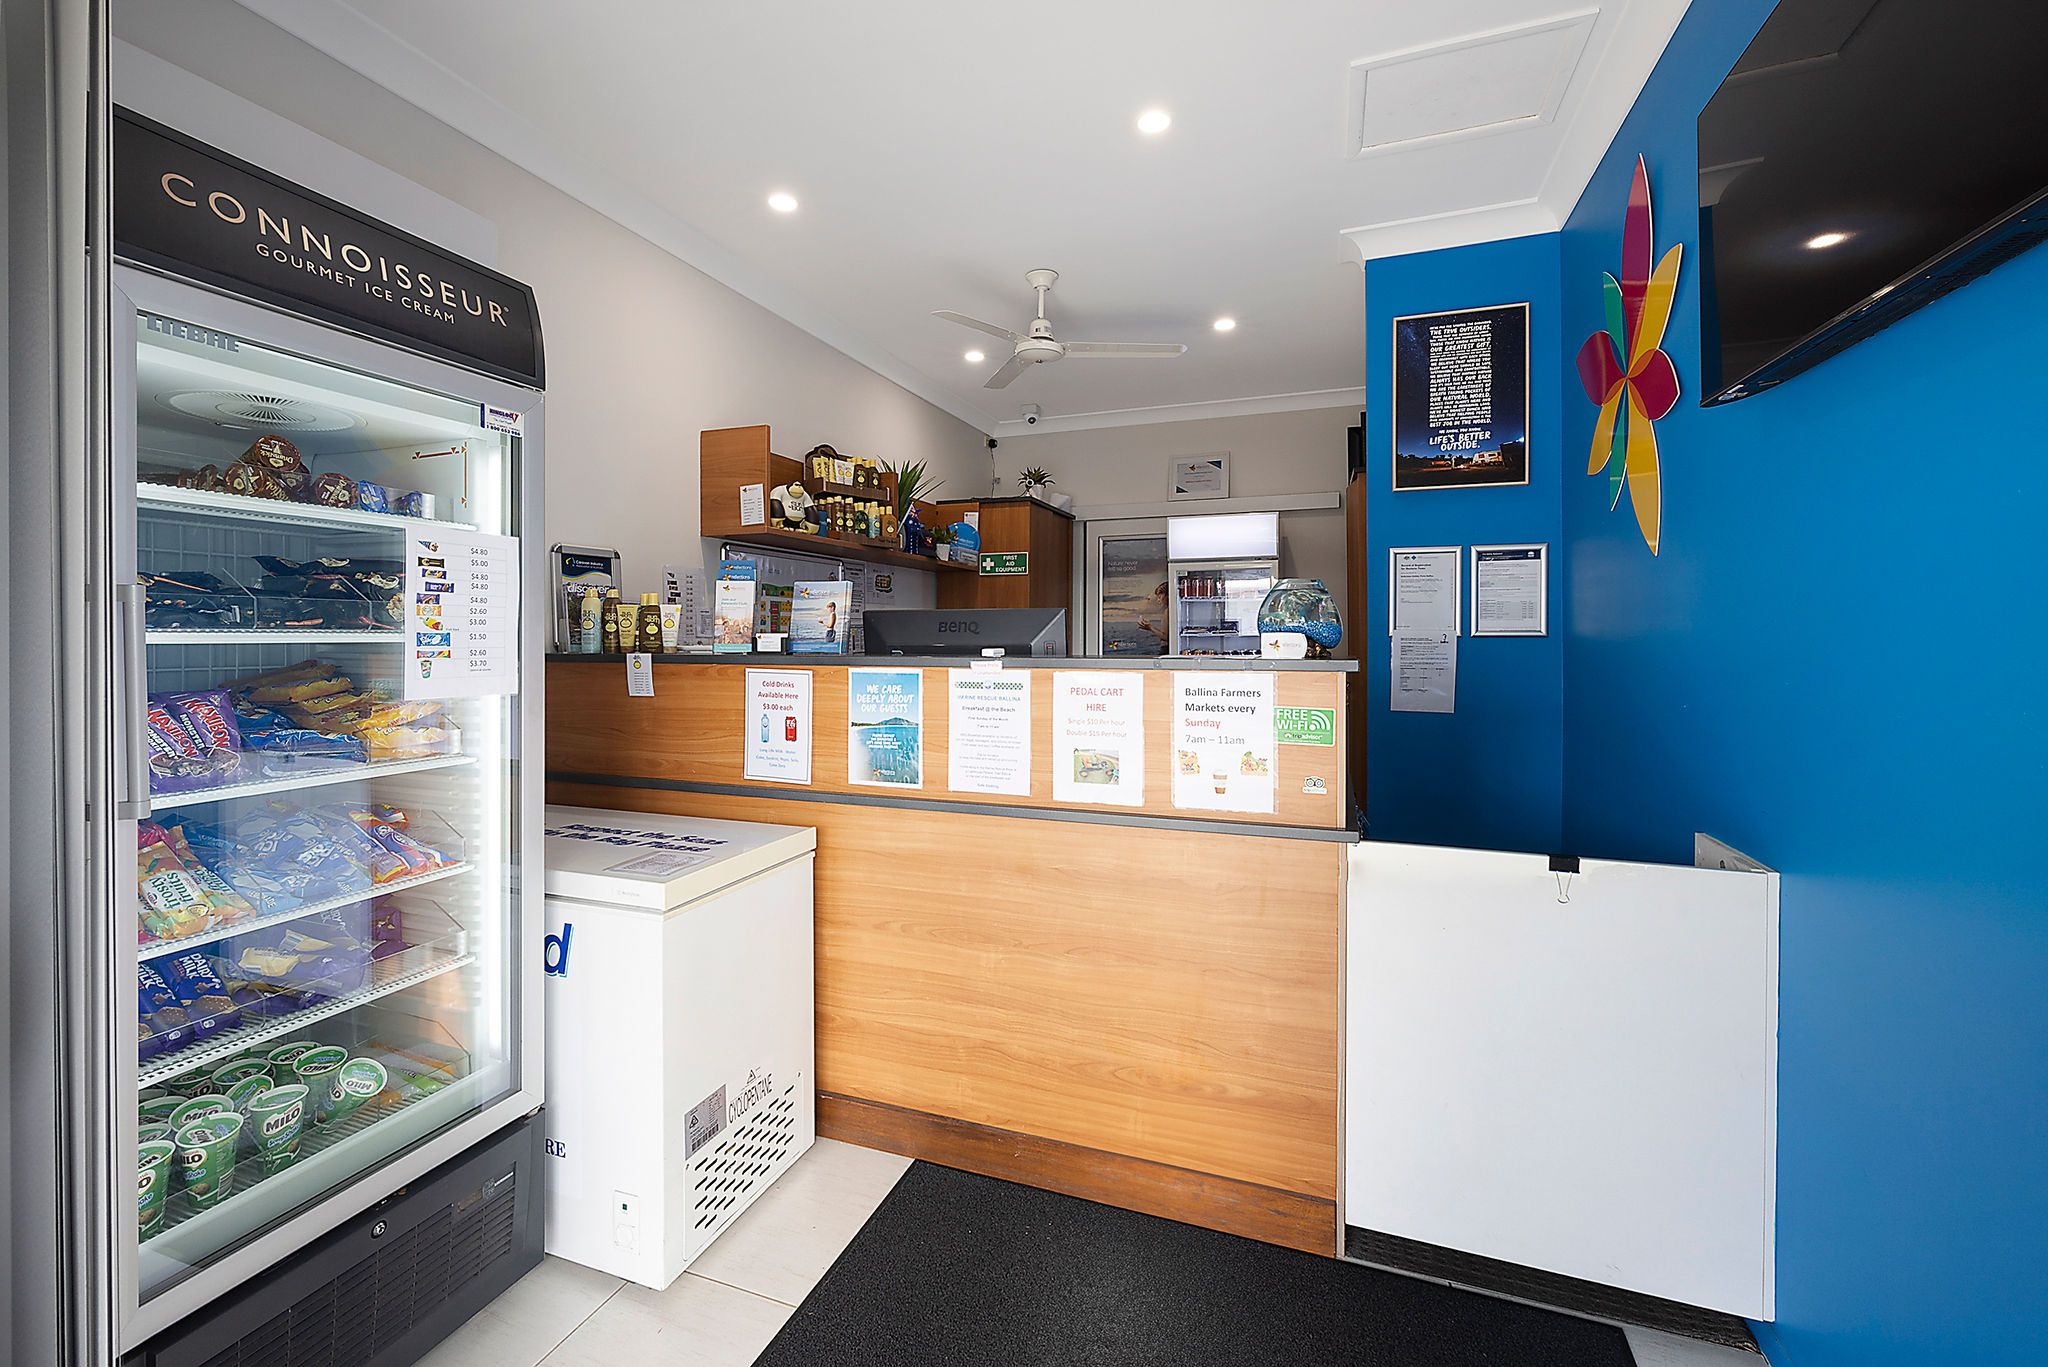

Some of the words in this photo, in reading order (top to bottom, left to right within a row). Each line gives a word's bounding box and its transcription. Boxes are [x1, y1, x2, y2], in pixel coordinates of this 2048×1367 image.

[161, 172, 507, 328] CONNOISSEUR
[256, 243, 356, 288] GOURMET
[365, 282, 393, 303] ICE
[401, 296, 455, 325] CREAM
[1445, 343, 1474, 351] GREATEST
[1430, 435, 1454, 445] LIFE'S
[1459, 431, 1490, 441] BETTER
[1441, 440, 1480, 451] OUTSIDE.
[471, 547, 488, 556] $4.80
[471, 559, 488, 567] $5.00
[471, 573, 488, 581] $4.80
[471, 582, 488, 590] $4.80
[470, 596, 488, 604] $4.80
[470, 607, 487, 615] $2.60
[469, 618, 487, 626] $3.00
[938, 621, 980, 634] BenQ
[469, 633, 486, 641] $1.50
[469, 649, 487, 657] $2.60
[470, 659, 487, 667] $3.70
[866, 684, 880, 694] WE
[881, 684, 903, 695] CARE
[1070, 687, 1098, 696] PEDAL
[1100, 687, 1124, 696] CART
[1185, 687, 1218, 697] Ballina
[1221, 688, 1261, 698] Farmers
[856, 694, 886, 704] DEEPLY
[887, 694, 915, 704] ABOUT
[762, 702, 779, 710] $3.00
[861, 704, 877, 713] OUR
[879, 704, 908, 713] GUESTS
[1086, 703, 1107, 711] HIRE
[1185, 702, 1225, 713] Markets
[1228, 705, 1256, 715] every
[1276, 708, 1308, 720] FREE
[177, 698, 231, 749] MAXIBON
[1184, 718, 1221, 729] Sunday
[1276, 720, 1308, 731] WI-FI
[179, 712, 206, 751] MONSTER
[148, 724, 179, 760] ONSTER
[1185, 734, 1206, 743] 7am
[1218, 735, 1245, 745] 11am
[166, 871, 195, 903] fruits
[149, 877, 181, 910] frosty
[179, 956, 200, 980] MILK
[190, 953, 215, 979] DAIRY
[728, 1072, 773, 1124] CYCLOPENTANE
[265, 1106, 301, 1134] MILO
[181, 1151, 204, 1166] ILO
